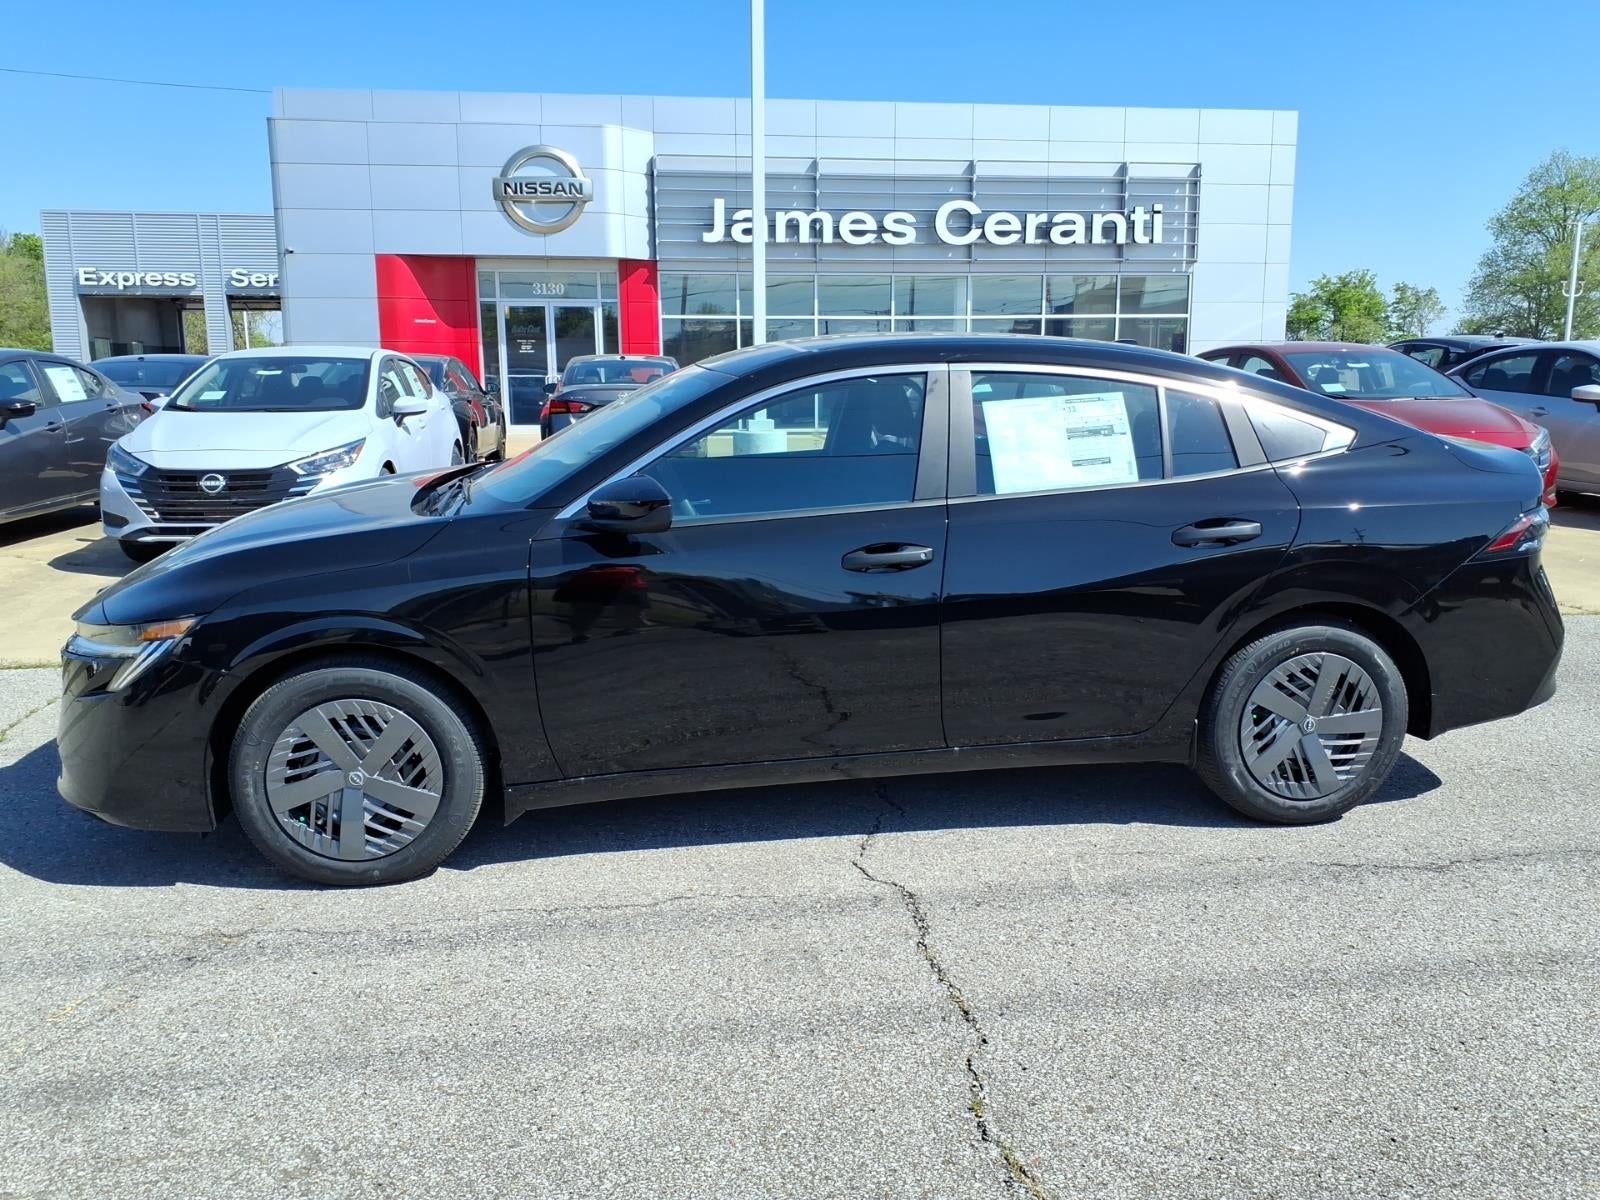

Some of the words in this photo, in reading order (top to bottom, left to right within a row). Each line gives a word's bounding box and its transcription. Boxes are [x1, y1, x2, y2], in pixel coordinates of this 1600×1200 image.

[502, 181, 585, 197] NISSAN
[703, 198, 917, 245] James
[935, 199, 1163, 245] Ceranti
[78, 267, 196, 290] Express
[231, 268, 279, 287] Ser
[532, 282, 565, 296] 3130
